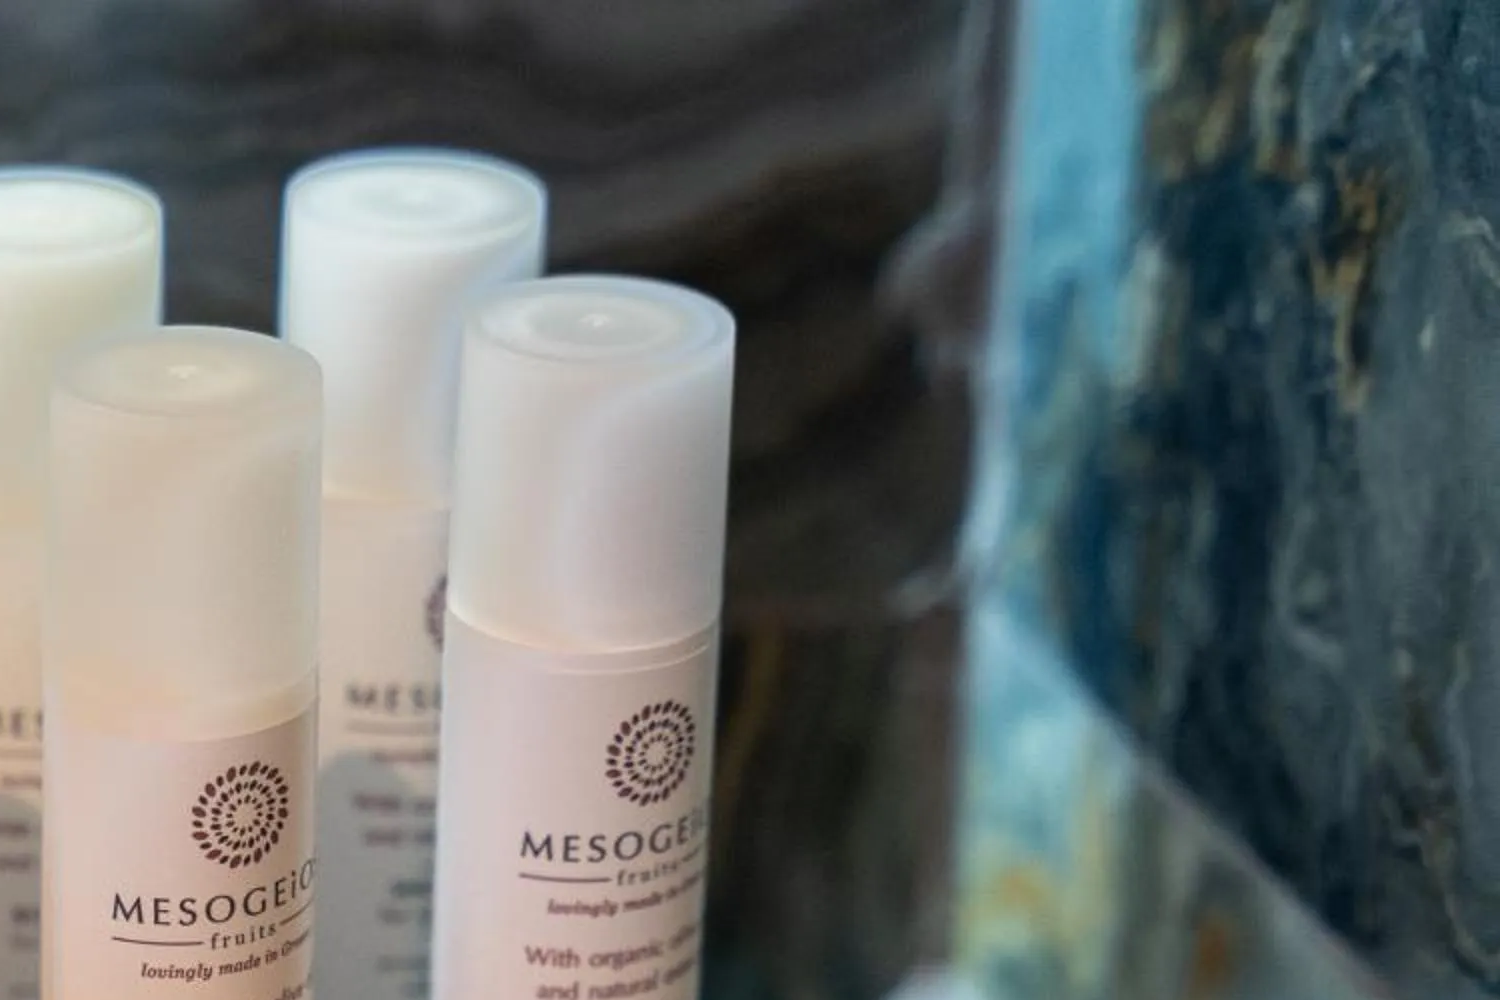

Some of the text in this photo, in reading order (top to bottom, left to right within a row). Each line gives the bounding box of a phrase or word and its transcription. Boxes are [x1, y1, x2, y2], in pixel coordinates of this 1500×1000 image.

[211, 924, 276, 950] fruits
[141, 961, 213, 981] lovingly
[219, 954, 261, 976] made
[524, 944, 581, 968] With
[536, 981, 579, 1000] and
